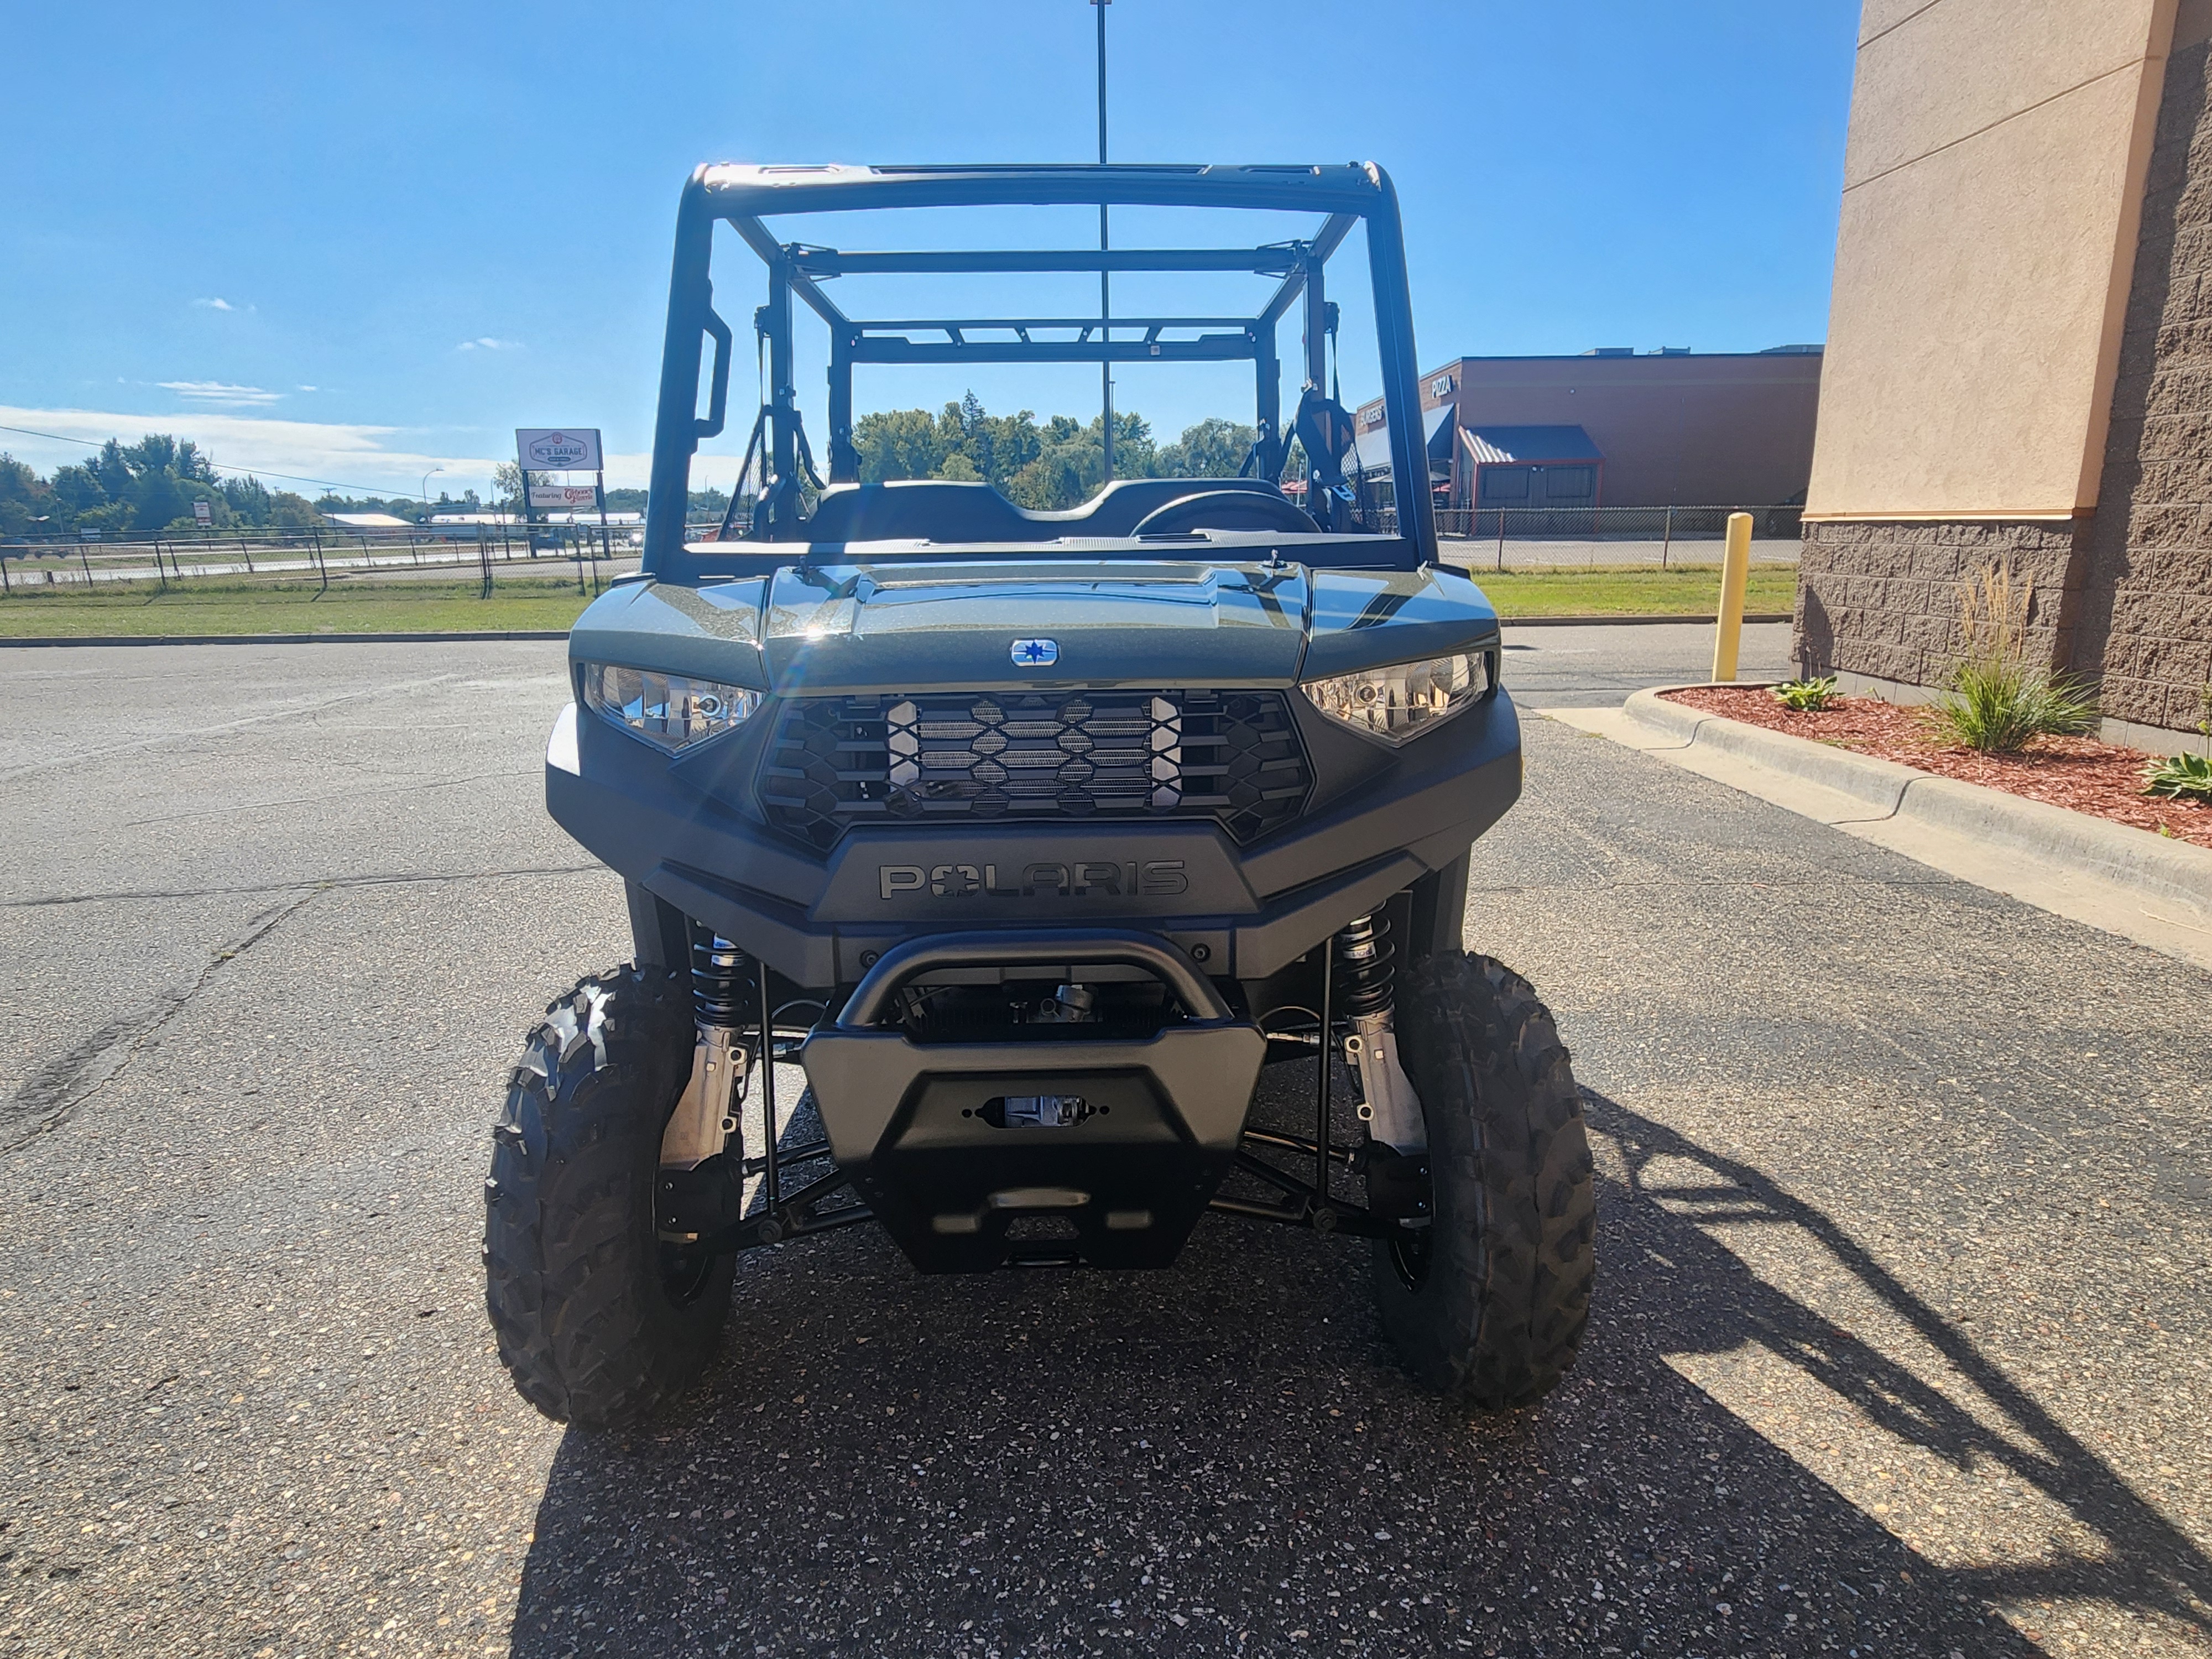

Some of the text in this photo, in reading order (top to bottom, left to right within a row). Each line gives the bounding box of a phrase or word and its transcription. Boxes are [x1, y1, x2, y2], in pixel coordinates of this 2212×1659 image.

[1432, 374, 1452, 399] PIZZA
[554, 447, 582, 456] GARAGE
[531, 491, 562, 500] Featuring
[879, 860, 1189, 900] POLARIS
